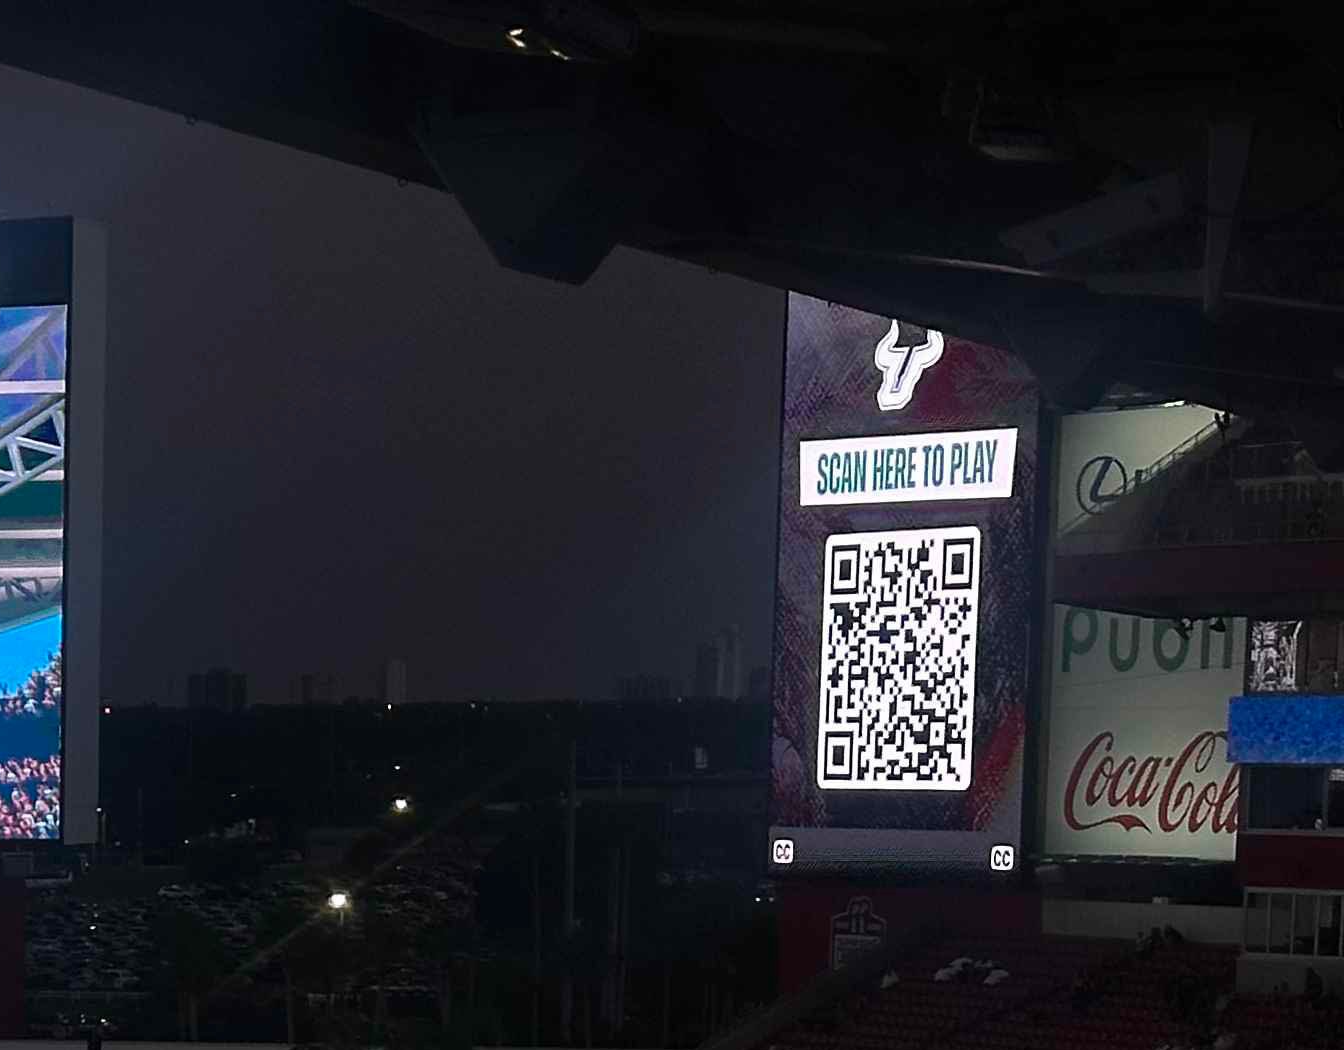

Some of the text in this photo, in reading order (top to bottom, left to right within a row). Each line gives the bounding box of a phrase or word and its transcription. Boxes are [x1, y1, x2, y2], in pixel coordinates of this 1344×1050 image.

[816, 440, 999, 495] SCAN HERE TO PLAY
[775, 844, 791, 861] CC
[993, 849, 1011, 866] CC
